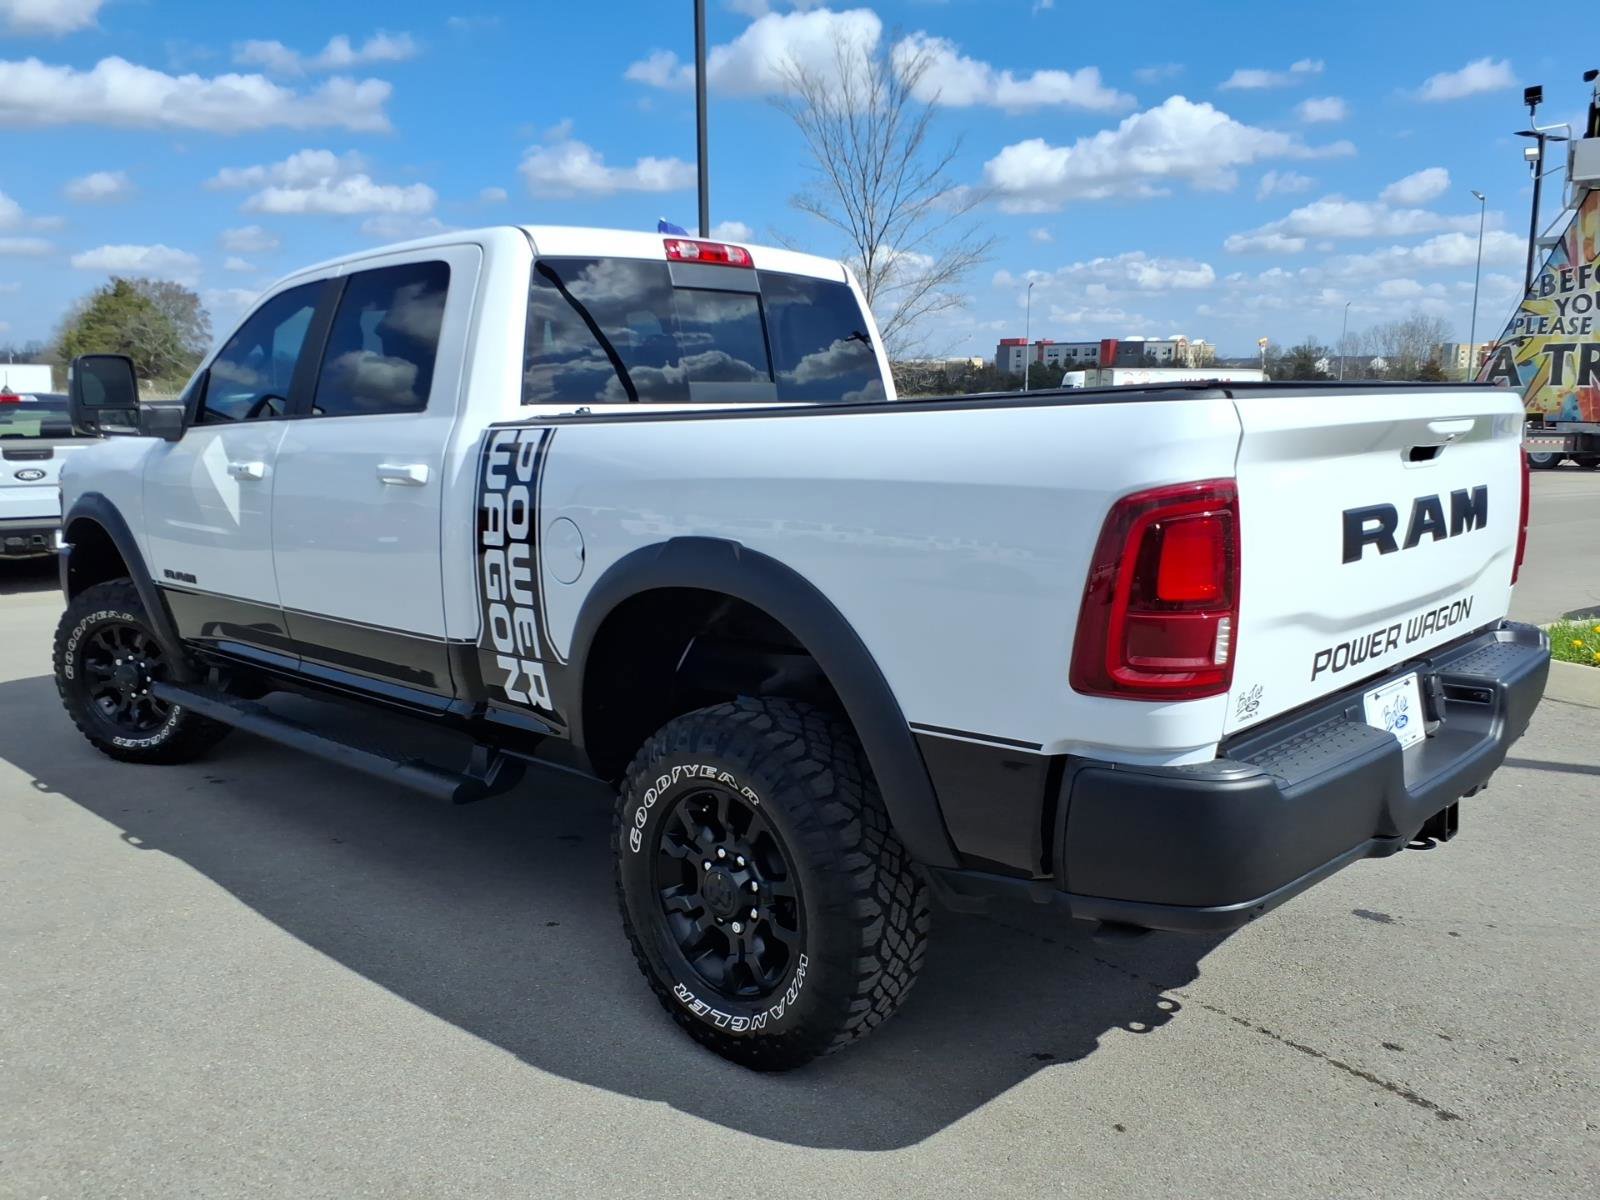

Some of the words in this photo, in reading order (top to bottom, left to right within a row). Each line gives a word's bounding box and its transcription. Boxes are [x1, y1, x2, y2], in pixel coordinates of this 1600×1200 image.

[1487, 343, 1522, 387] A
[1512, 316, 1592, 335] PLEASE
[1342, 484, 1489, 564] RAM
[483, 429, 529, 704] WAGON
[507, 429, 553, 711] POWER
[1310, 622, 1401, 682] POWER
[1405, 595, 1474, 643] WAGON
[629, 764, 760, 853] GOODYEAR
[673, 953, 809, 1033] WRANGLER
